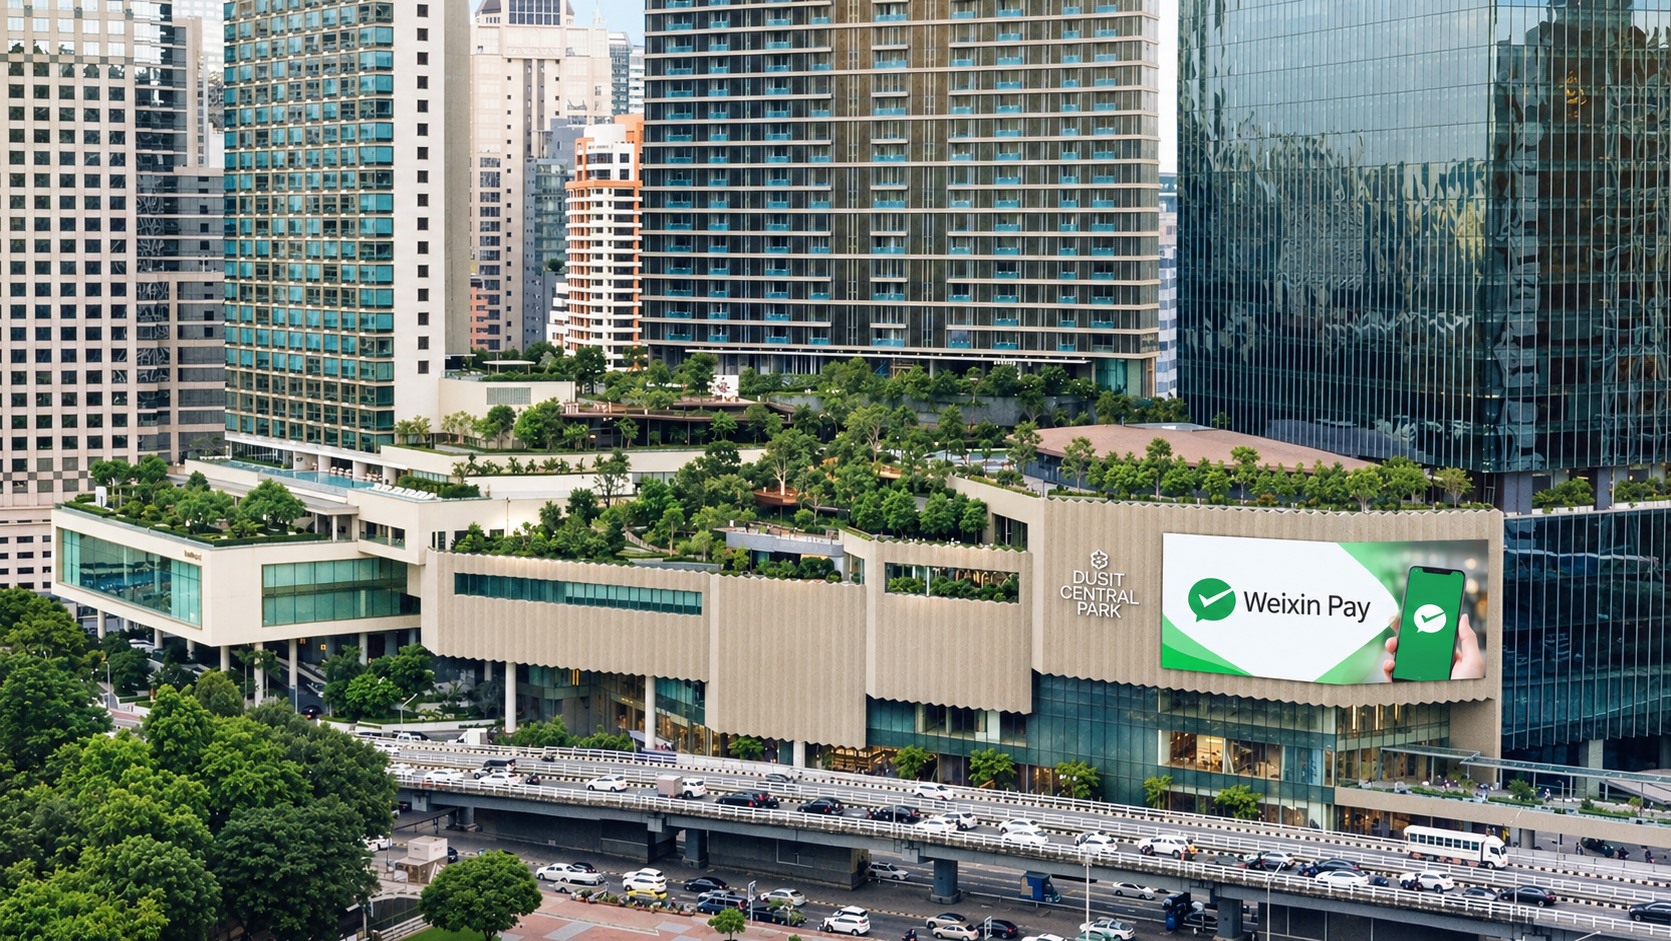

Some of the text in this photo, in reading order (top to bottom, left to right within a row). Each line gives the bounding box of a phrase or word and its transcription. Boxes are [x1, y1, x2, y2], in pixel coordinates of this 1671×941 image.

[1073, 570, 1125, 587] DUSIT
[1060, 585, 1140, 605] CENTRAL
[1077, 601, 1122, 619] PARK
[1243, 591, 1371, 623] Weixin Pay
